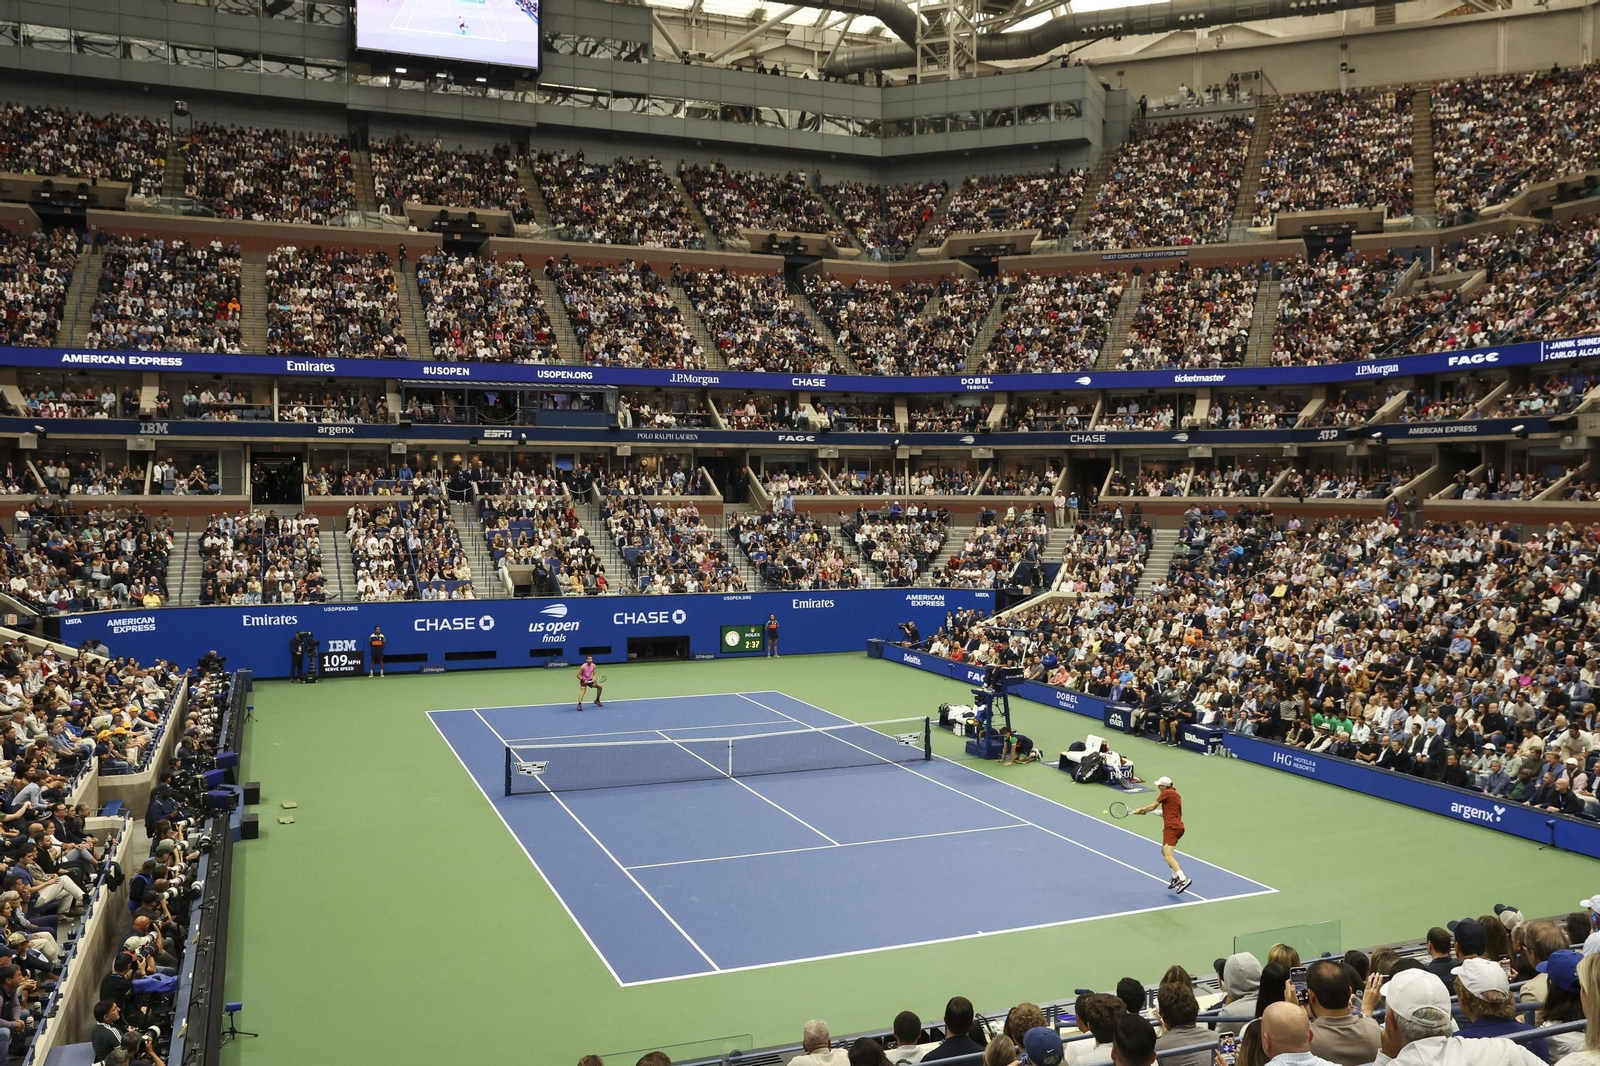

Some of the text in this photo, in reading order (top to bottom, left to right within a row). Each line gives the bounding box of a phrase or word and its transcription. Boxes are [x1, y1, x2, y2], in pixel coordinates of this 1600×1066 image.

[1550, 340, 1576, 350] JANNIK
[62, 354, 182, 366] AMERICAN EXPRESS
[1448, 352, 1499, 366] FAGE
[1550, 350, 1577, 360] CARLOS
[287, 361, 335, 372] Emirates
[423, 367, 469, 375] #USOPEN
[1356, 365, 1398, 375] J.P.Morgan
[538, 370, 592, 379] USOPEN.ORG
[670, 374, 719, 385] J.P.Morgan
[1175, 374, 1225, 382] ticketmaster
[792, 378, 825, 386] CHASE
[140, 423, 168, 434] IBM
[318, 425, 355, 436] argenx
[1445, 425, 1477, 433] EXPRESS
[1318, 429, 1338, 440] ATP
[793, 599, 834, 608] Emirates
[906, 594, 945, 602] AMERICAN
[107, 617, 155, 627] AMERICAN
[243, 614, 297, 626] Emirates
[614, 612, 669, 624] CHASE
[113, 625, 155, 633] EXPRESS
[415, 618, 475, 631] CHASE
[528, 621, 579, 634] us open
[542, 634, 566, 643] finals
[328, 640, 356, 652] IBM
[745, 641, 760, 649] 2:37
[323, 654, 348, 667] 109
[1056, 691, 1079, 704] DOBEL
[1058, 701, 1076, 709] TEQUILA
[1109, 716, 1124, 728] evian
[1184, 732, 1206, 746] Wilson
[1272, 751, 1292, 766] IHG
[1293, 757, 1312, 766] HOTELS
[1082, 764, 1100, 781] HEAD
[1293, 763, 1316, 773] RESORTS
[1451, 802, 1493, 822] argenx
